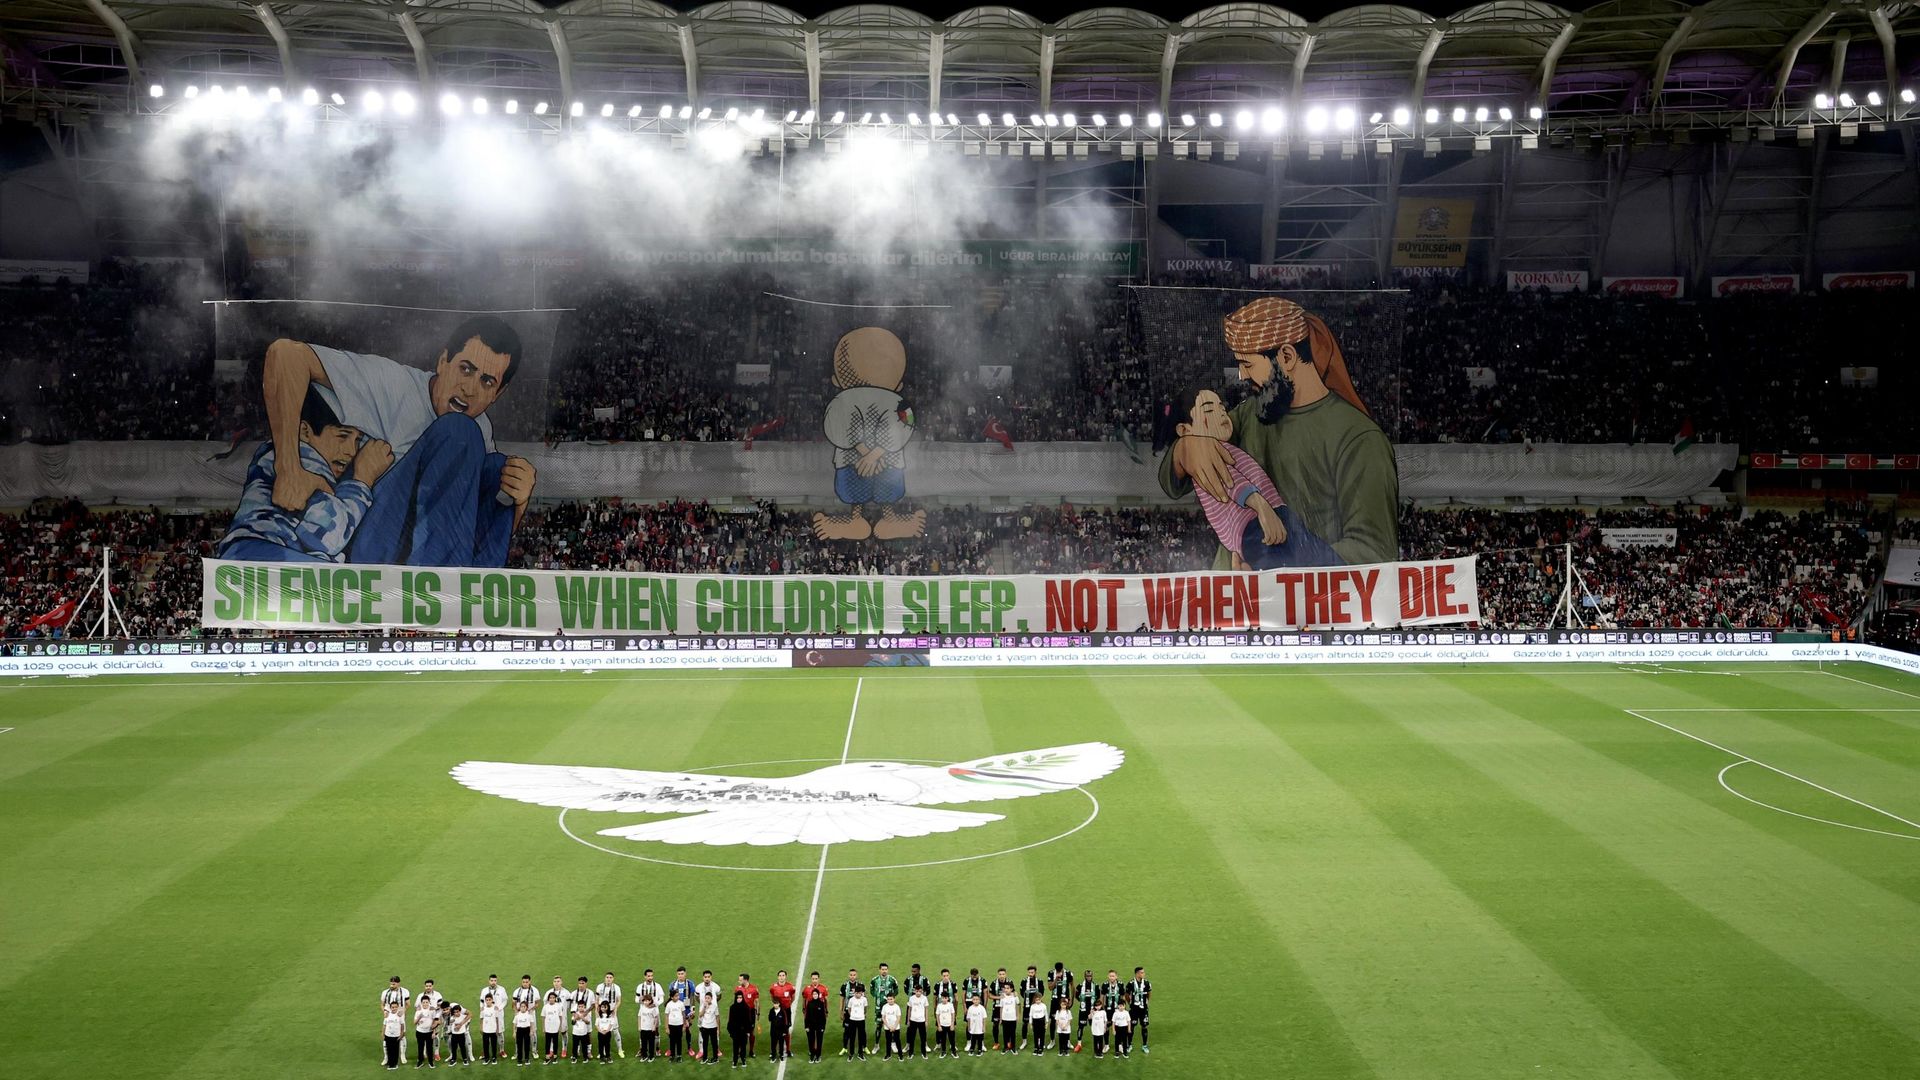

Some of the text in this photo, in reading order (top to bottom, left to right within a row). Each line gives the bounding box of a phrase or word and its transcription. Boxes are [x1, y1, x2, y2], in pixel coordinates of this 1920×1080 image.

[1000, 250, 1034, 261] UĞUR
[1094, 251, 1130, 262] ALTAY
[1167, 259, 1232, 272] KORKMAZ
[1514, 272, 1582, 285] KORKMAZ
[214, 564, 1469, 633] SILENCE IS FOR WHEN CHILDREN SLEEP. NOT WHEN THEY DIE.
[996, 653, 1002, 661] 1
[1040, 653, 1079, 661] altında
[1082, 653, 1110, 661] 1029
[1113, 653, 1148, 662] çocuk
[1230, 651, 1281, 659] Gazze'de
[1285, 651, 1290, 659] 1
[1328, 651, 1365, 659] altında
[1398, 651, 1433, 660] çocuk
[1608, 649, 1645, 657] altında
[1678, 650, 1713, 658] çocuk
[191, 660, 246, 668] Gazze'de
[251, 659, 257, 668] 1
[299, 659, 340, 667] altında
[376, 658, 416, 668] çocuk
[502, 657, 556, 665] Gazze'de
[560, 657, 566, 665] 1
[605, 656, 645, 664] altında
[681, 656, 717, 666] çocuk
[1903, 659, 1919, 668] 1029
[23, 662, 54, 670] 1029
[58, 662, 98, 672] çocuk
